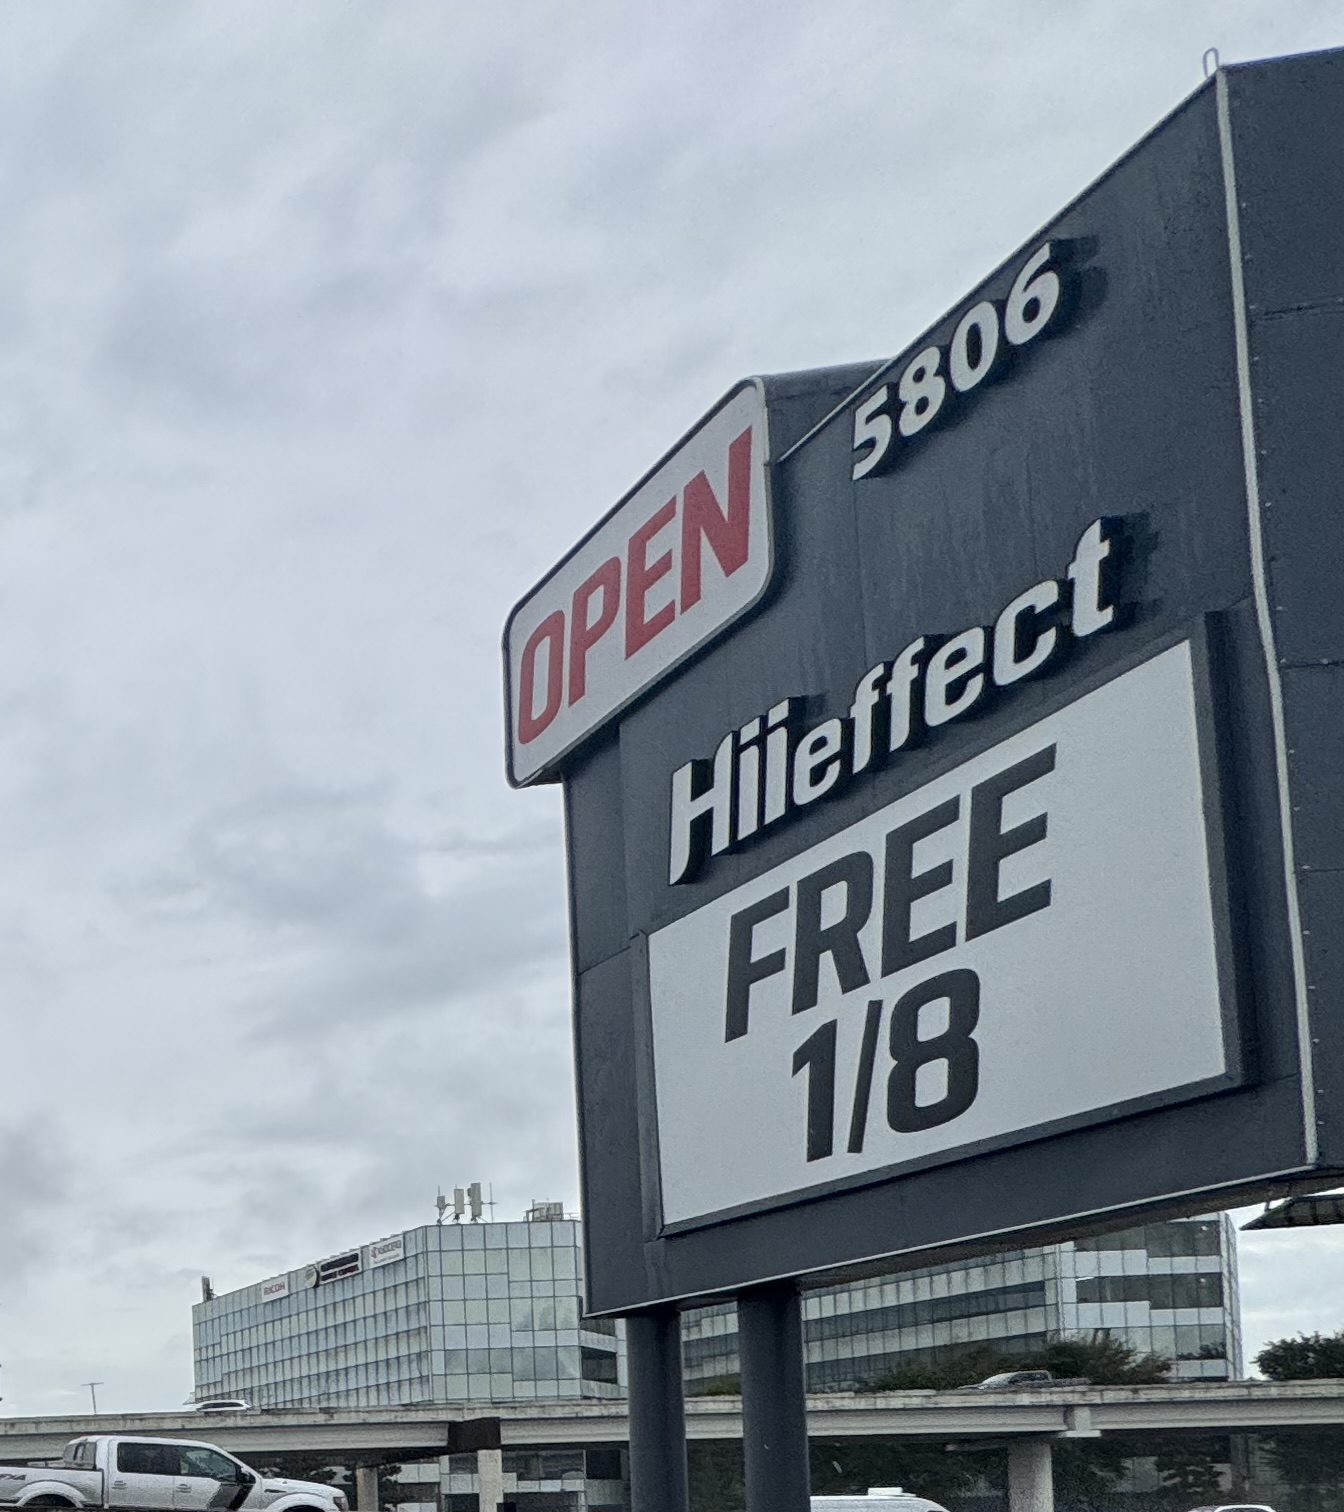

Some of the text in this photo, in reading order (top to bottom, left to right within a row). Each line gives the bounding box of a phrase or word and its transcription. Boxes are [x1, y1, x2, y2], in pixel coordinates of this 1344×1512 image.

[852, 242, 1061, 481] 5806
[518, 425, 752, 745] OPEN
[669, 518, 1115, 887] Hiieffect
[725, 742, 1057, 1044] FREE
[792, 968, 981, 1164] 1/8
[263, 1281, 286, 1296] RICOH
